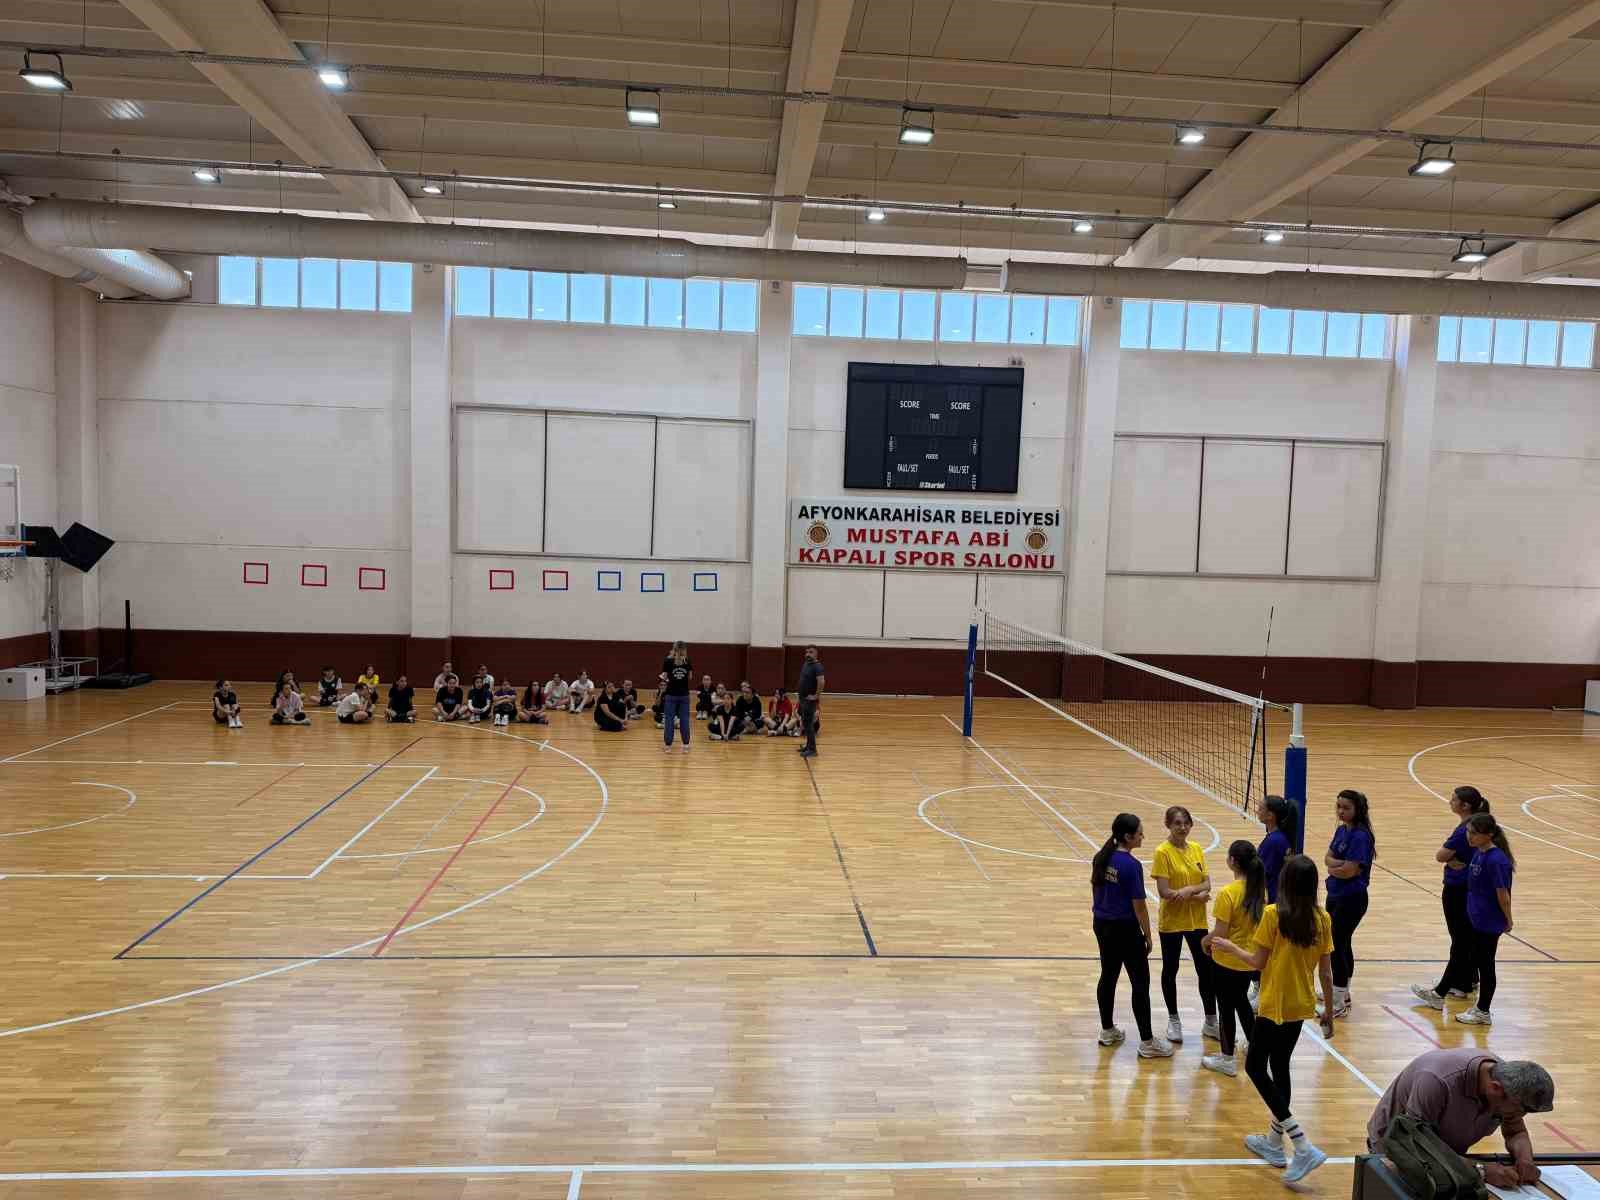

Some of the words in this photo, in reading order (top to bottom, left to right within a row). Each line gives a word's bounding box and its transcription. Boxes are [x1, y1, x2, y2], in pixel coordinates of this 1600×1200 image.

[899, 400, 920, 409] SCORE
[950, 401, 971, 410] SCORE
[798, 505, 956, 524] AFYONKARAHİSAR
[961, 508, 1060, 527] BELEDİYESİ
[847, 528, 960, 546] MUSTAFA
[968, 529, 1009, 547] ABİ
[799, 548, 886, 565] KAPALI
[894, 551, 955, 567] SPOR
[963, 552, 1055, 569] SALONU
